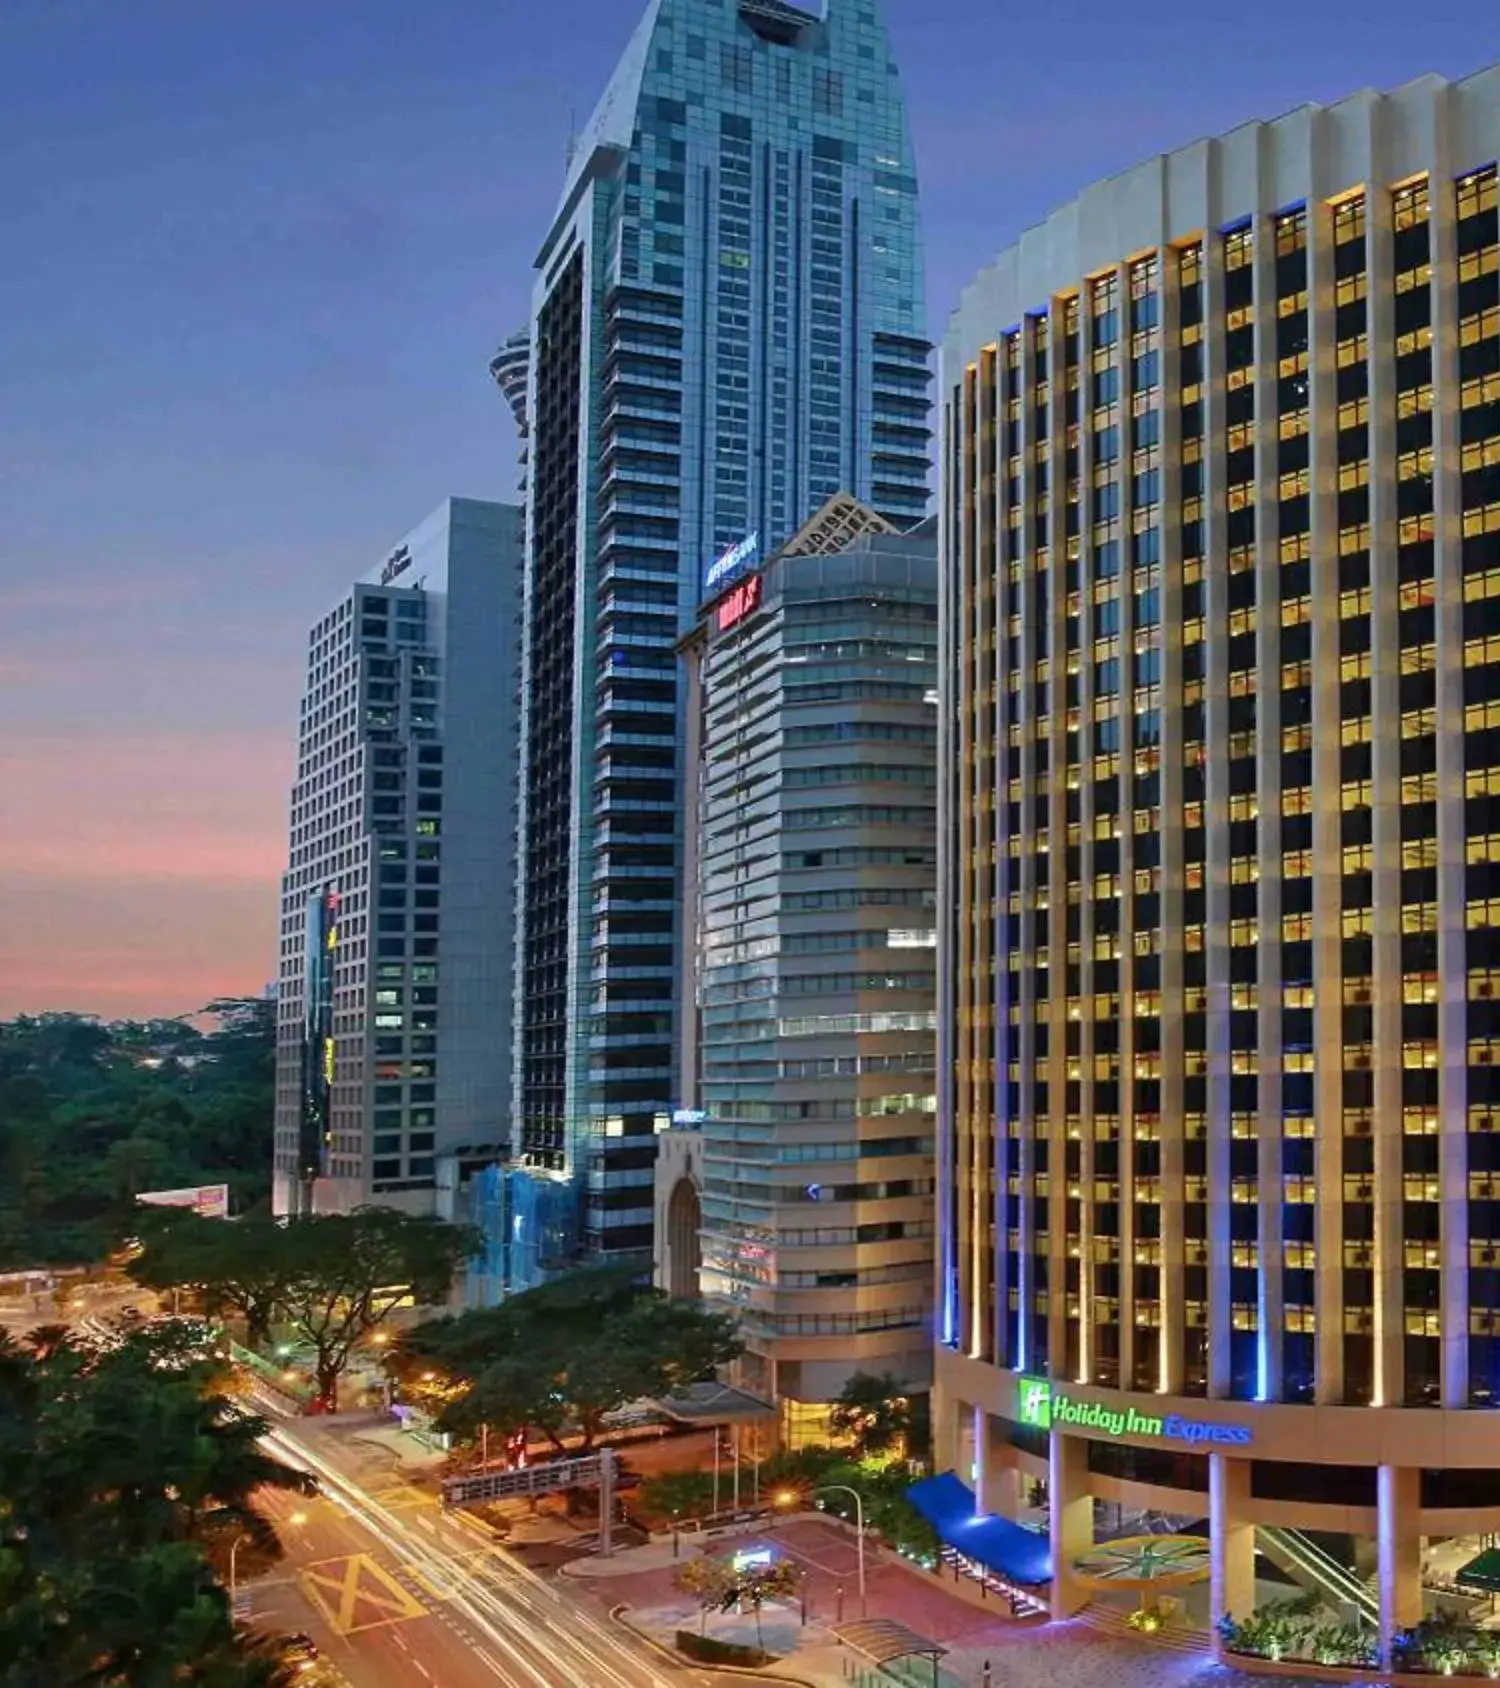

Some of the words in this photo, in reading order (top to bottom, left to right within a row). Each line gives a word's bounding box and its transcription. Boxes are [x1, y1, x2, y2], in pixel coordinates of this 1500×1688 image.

[1053, 1395, 1125, 1435] Holiday
[1126, 1407, 1162, 1435] Inn
[1164, 1416, 1251, 1444] Express
